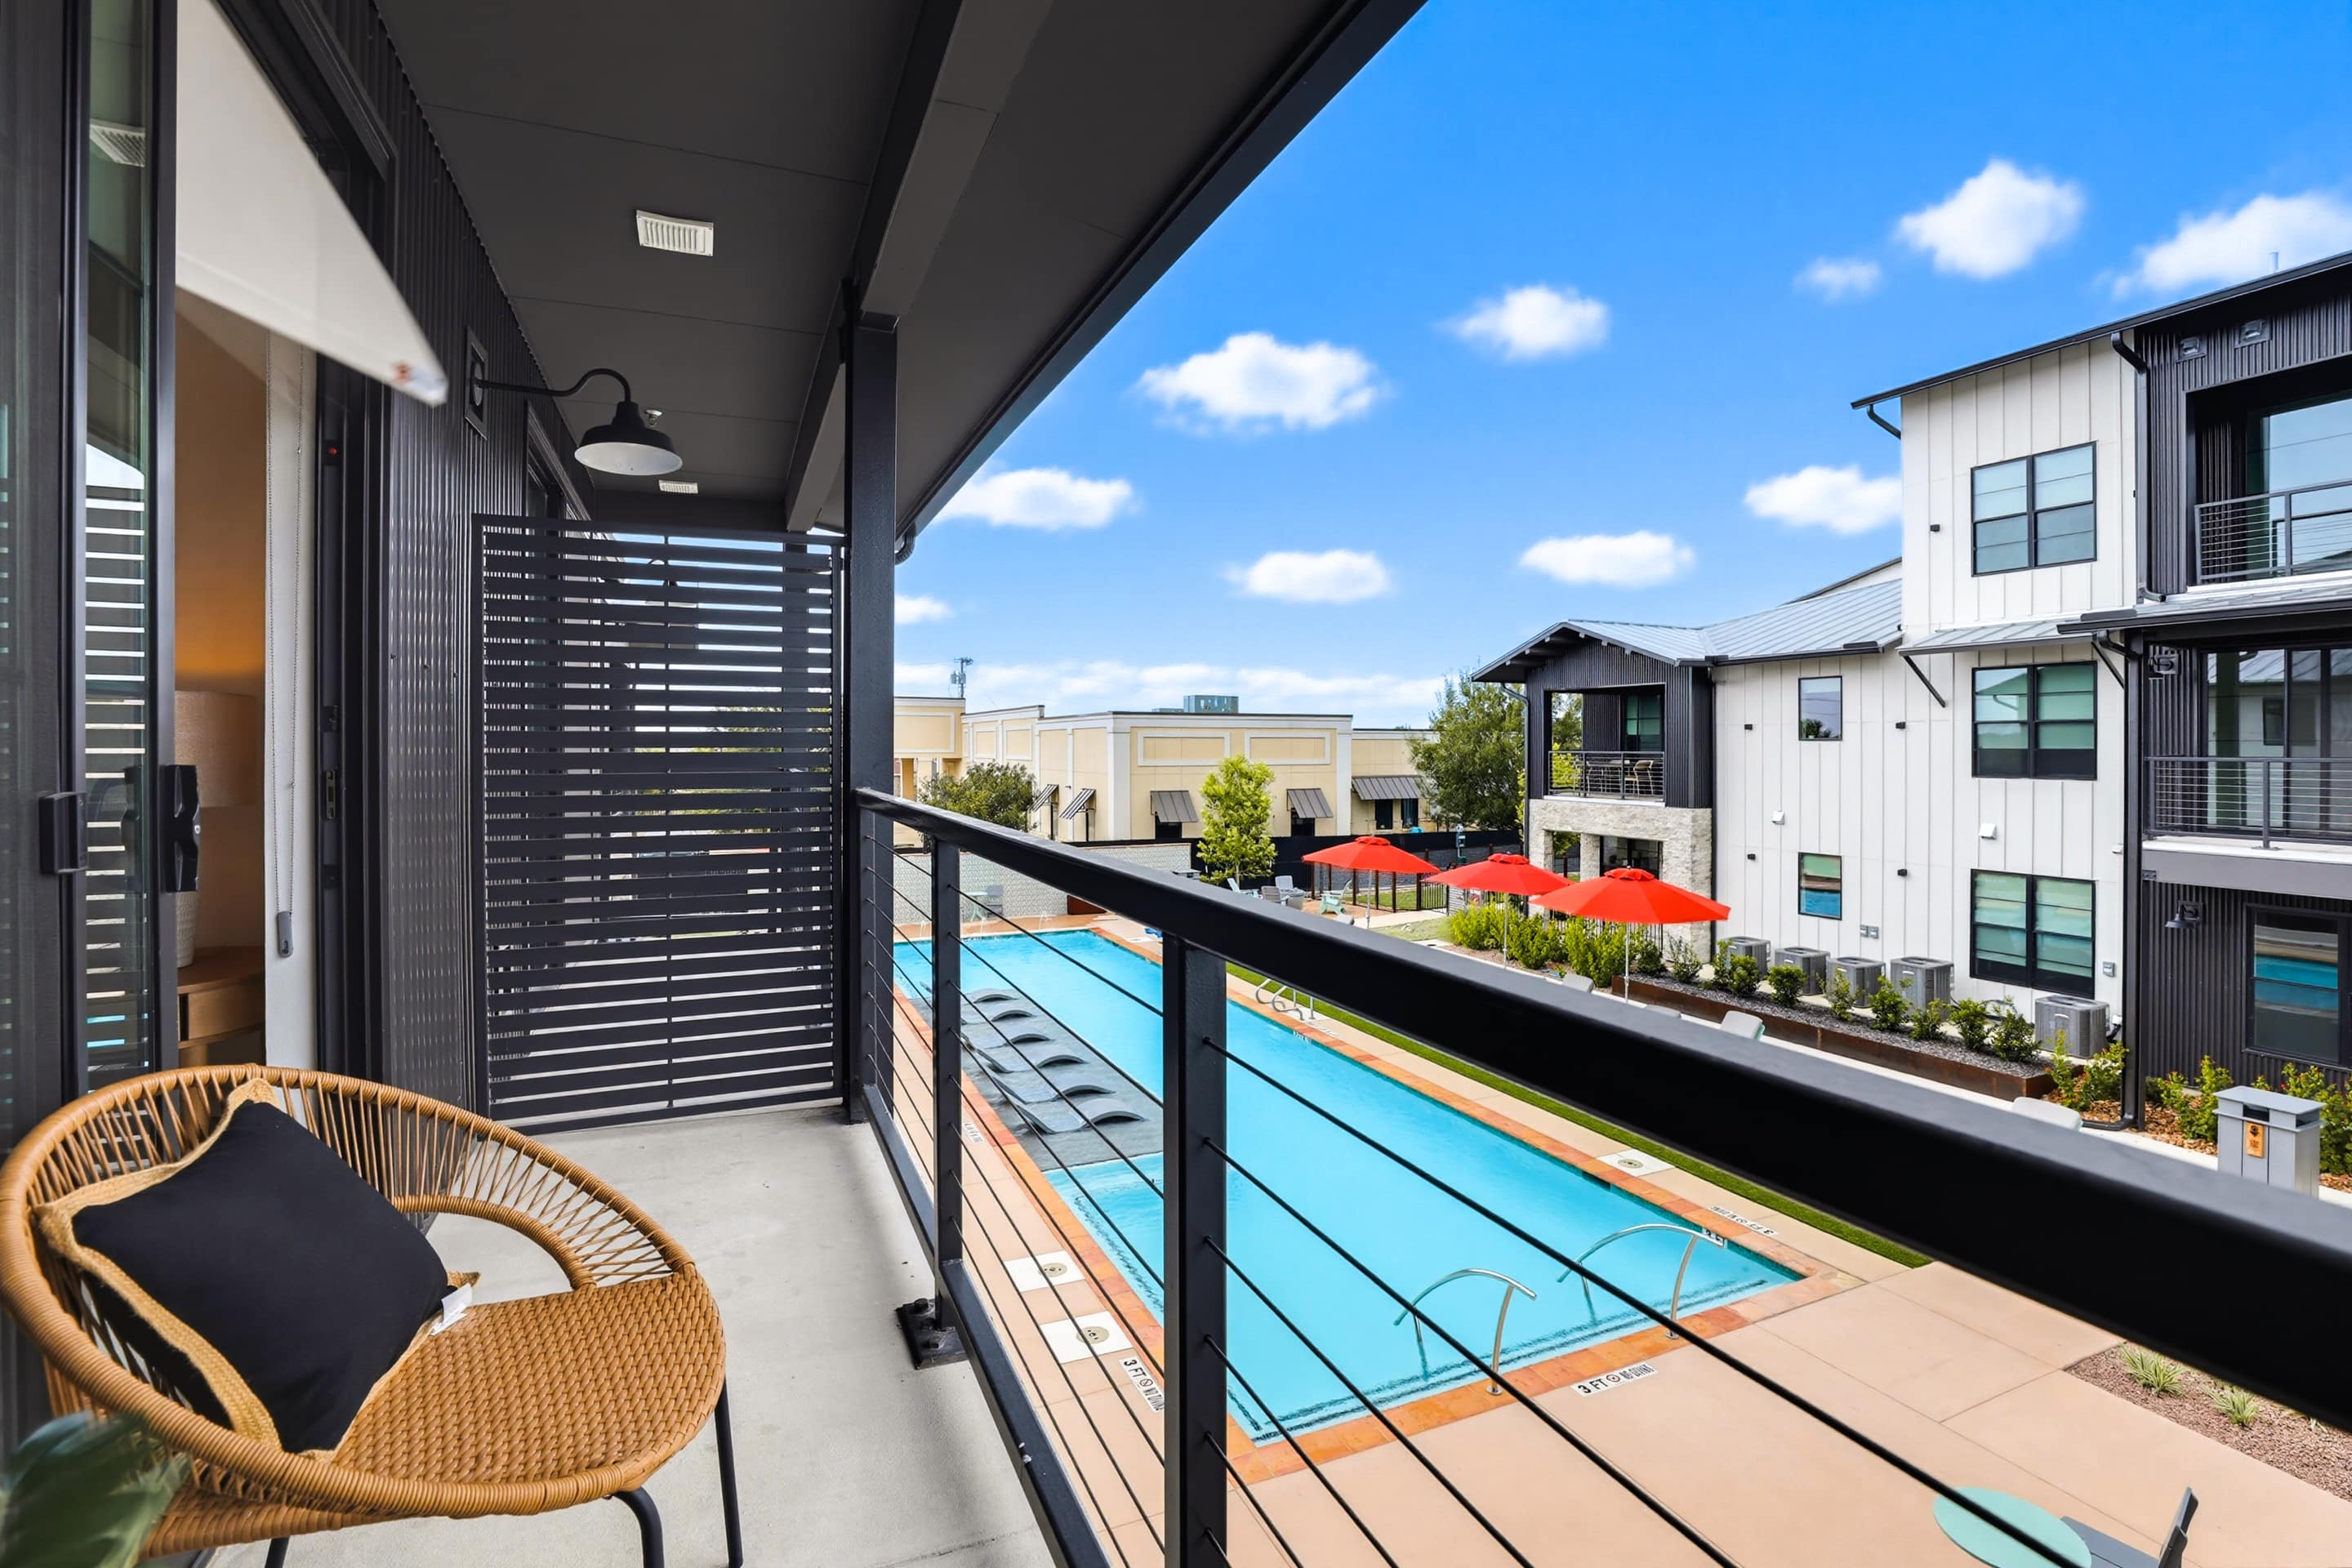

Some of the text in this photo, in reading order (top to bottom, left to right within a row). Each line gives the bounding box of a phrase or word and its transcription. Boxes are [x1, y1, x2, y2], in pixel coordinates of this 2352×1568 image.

[1129, 1367, 1147, 1377] FT
[1578, 1384, 1592, 1394] 3
[1589, 1379, 1608, 1390] FT
